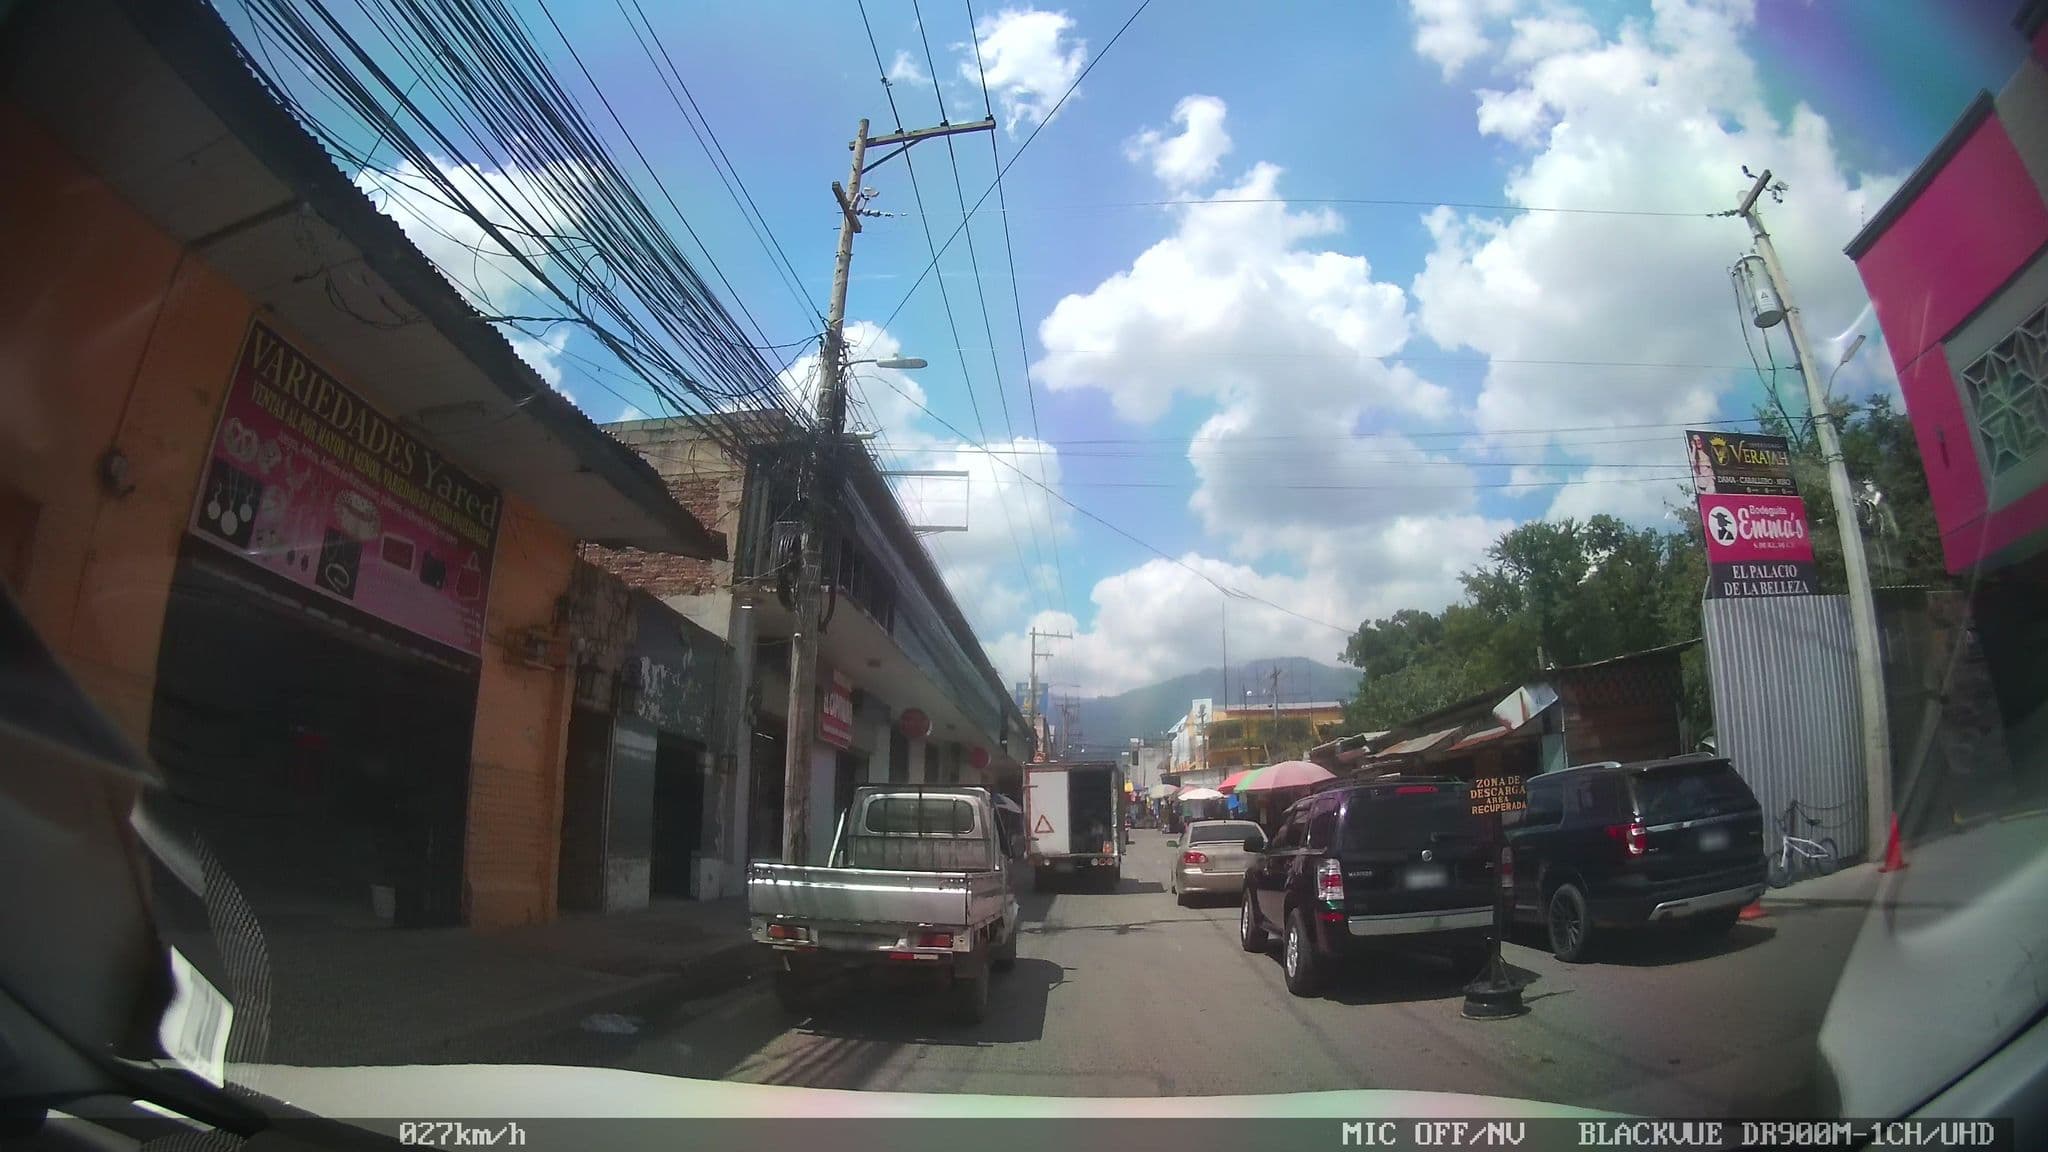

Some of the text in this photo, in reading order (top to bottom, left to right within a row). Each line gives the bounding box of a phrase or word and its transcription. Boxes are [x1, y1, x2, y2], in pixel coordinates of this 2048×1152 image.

[252, 327, 417, 475] VARIEDADES
[424, 451, 499, 529] Yared
[1749, 505, 1788, 517] Bodeguita
[1738, 507, 1804, 539] Emma's
[1732, 564, 1797, 579] EL PALACIO
[1724, 580, 1810, 596] DE LA BELLEZA
[1476, 775, 1521, 788] ZONA DE
[1470, 785, 1527, 799] DESCARGA
[1486, 796, 1509, 804] AREA
[1471, 801, 1527, 815] RECUPERADA
